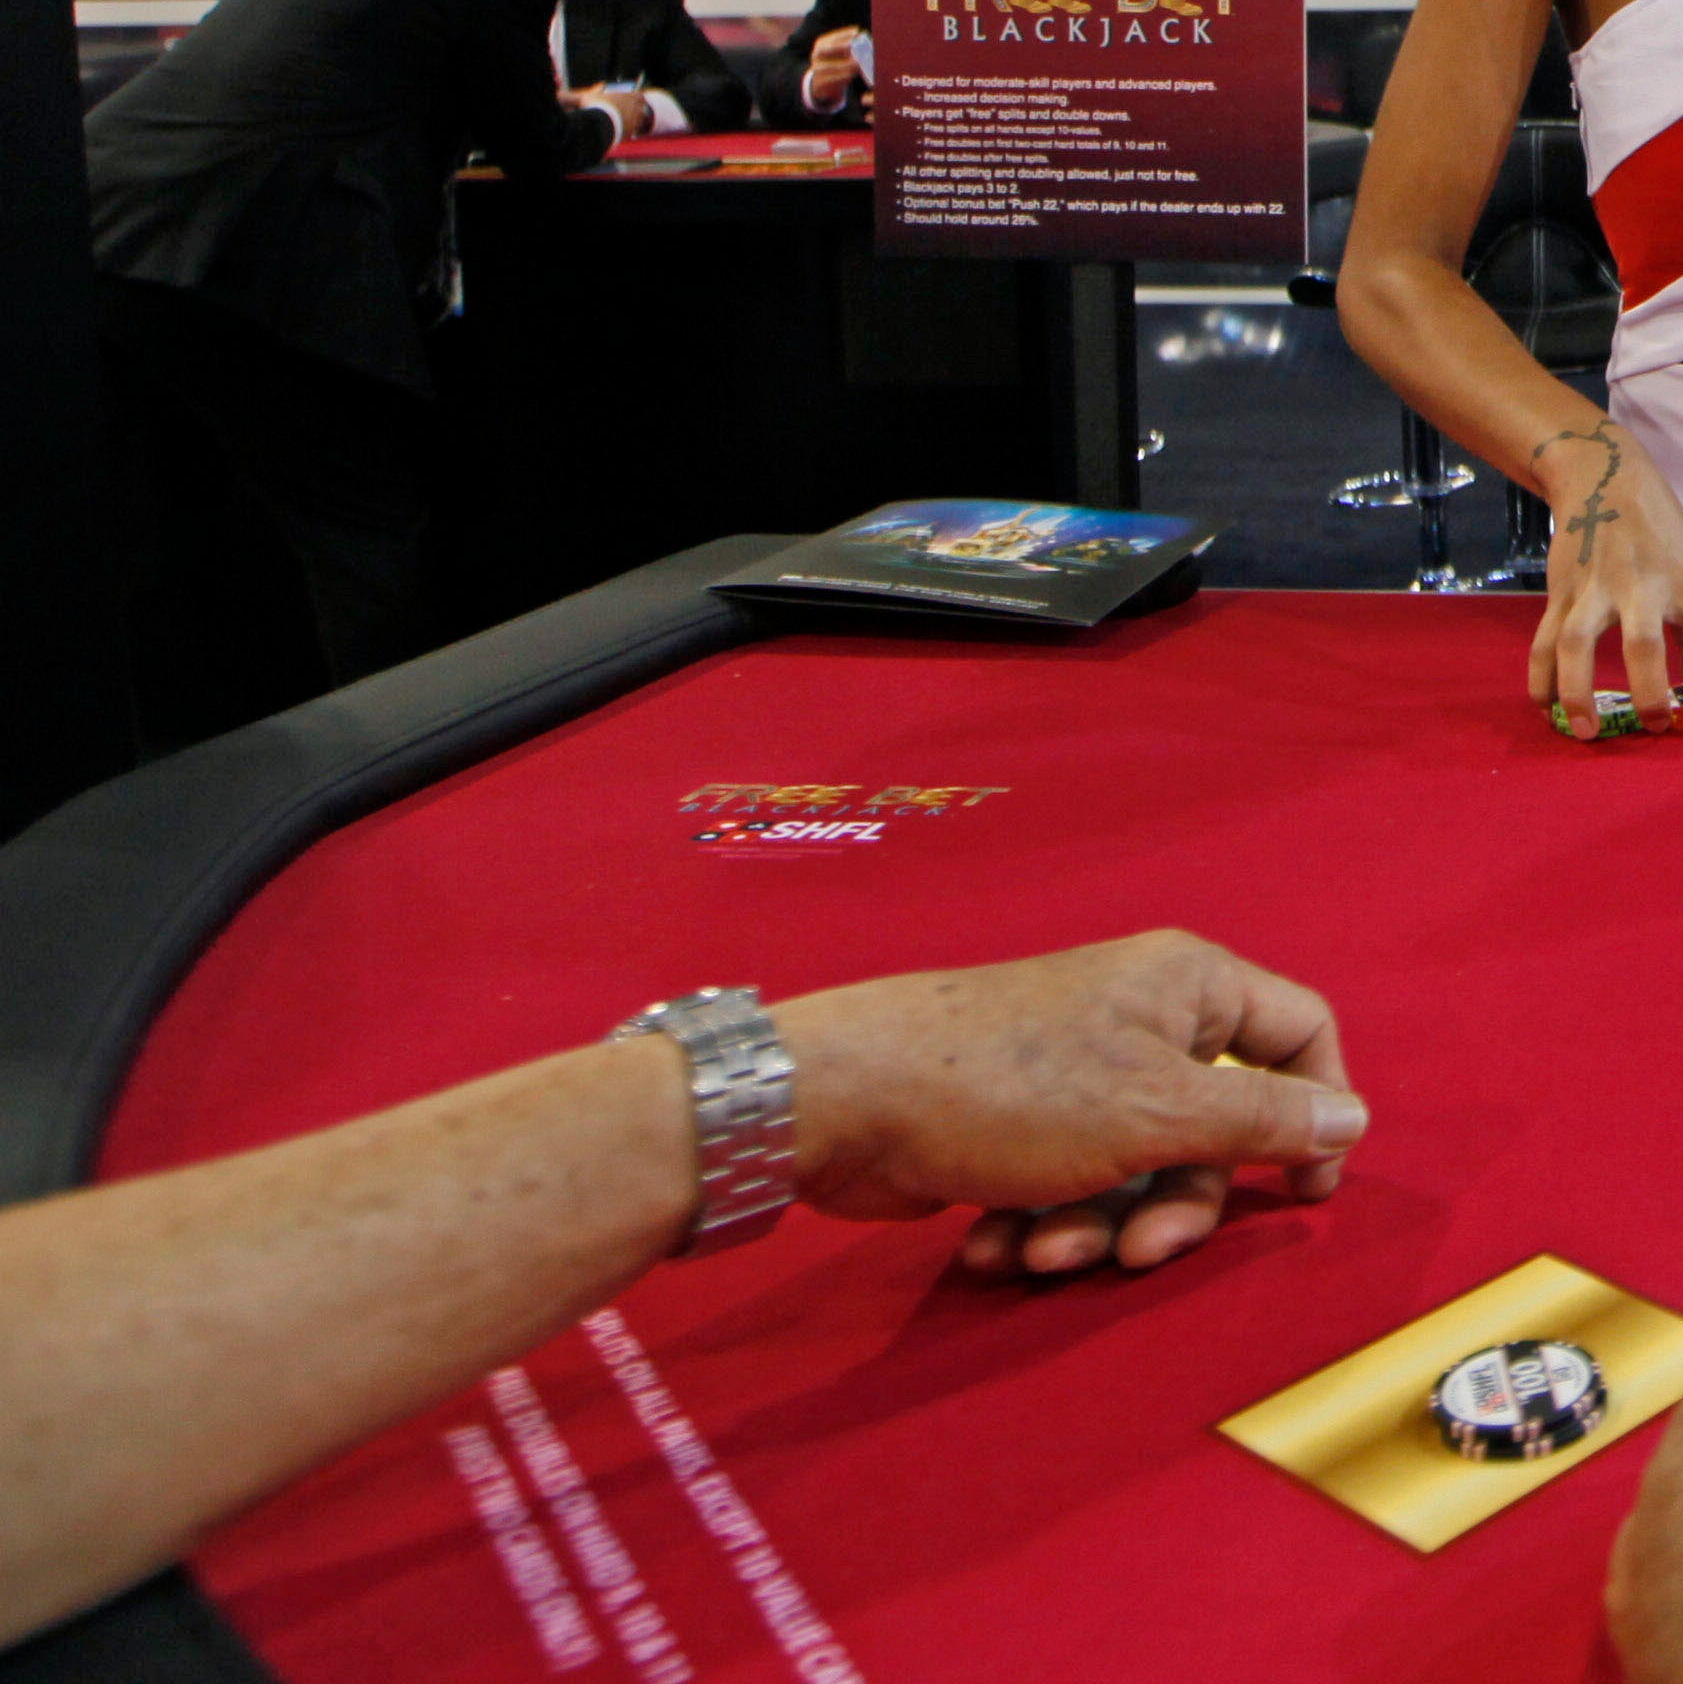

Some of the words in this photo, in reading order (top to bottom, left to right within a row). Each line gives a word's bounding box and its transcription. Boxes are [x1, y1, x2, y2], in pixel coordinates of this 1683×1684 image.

[942, 16, 1214, 48] BLACKJACK
[902, 76, 954, 90] Designed
[956, 77, 971, 88] for
[973, 77, 1050, 88] moderate-skill
[1052, 79, 1092, 92] players
[1094, 79, 1116, 90] and
[1118, 79, 1172, 90] advanced
[1174, 80, 1218, 93] players.
[923, 92, 978, 104] Increased
[979, 93, 1026, 104] decision
[1027, 95, 1070, 108] making.
[902, 107, 944, 121] Players
[946, 108, 964, 122] get
[998, 109, 1027, 122] splits
[1029, 110, 1051, 120] and
[1052, 110, 1091, 121] double
[1092, 111, 1132, 122] downs.
[903, 165, 917, 177] All
[919, 166, 947, 177] other
[950, 167, 993, 180] splitting
[994, 168, 1015, 178] and
[1017, 168, 1065, 181] doubling
[1114, 169, 1135, 183] just
[1137, 170, 1155, 181] not
[1157, 170, 1174, 181] for
[1175, 170, 1200, 182] free.
[903, 181, 956, 194] Blackjack
[957, 184, 984, 195] pays
[985, 183, 994, 193] 3
[996, 184, 1008, 193] to
[1010, 184, 1021, 194] 2.
[903, 196, 949, 210] Optional
[951, 198, 986, 209] bonus
[988, 198, 1006, 209] bet
[1067, 200, 1100, 212] which
[1101, 202, 1128, 214] pays
[1130, 200, 1138, 212] if
[1139, 201, 1157, 212] the
[1159, 202, 1195, 213] dealer
[1197, 202, 1225, 213] ends
[1227, 204, 1242, 216] up
[1244, 202, 1267, 214] with
[1268, 203, 1286, 215] 22.
[904, 212, 943, 225] Should
[944, 213, 968, 224] hold
[971, 214, 1010, 225] around
[679, 783, 864, 805] FREE
[866, 786, 1013, 807] BET
[678, 802, 950, 816] BLACKJACK
[760, 820, 887, 842] SHFL
